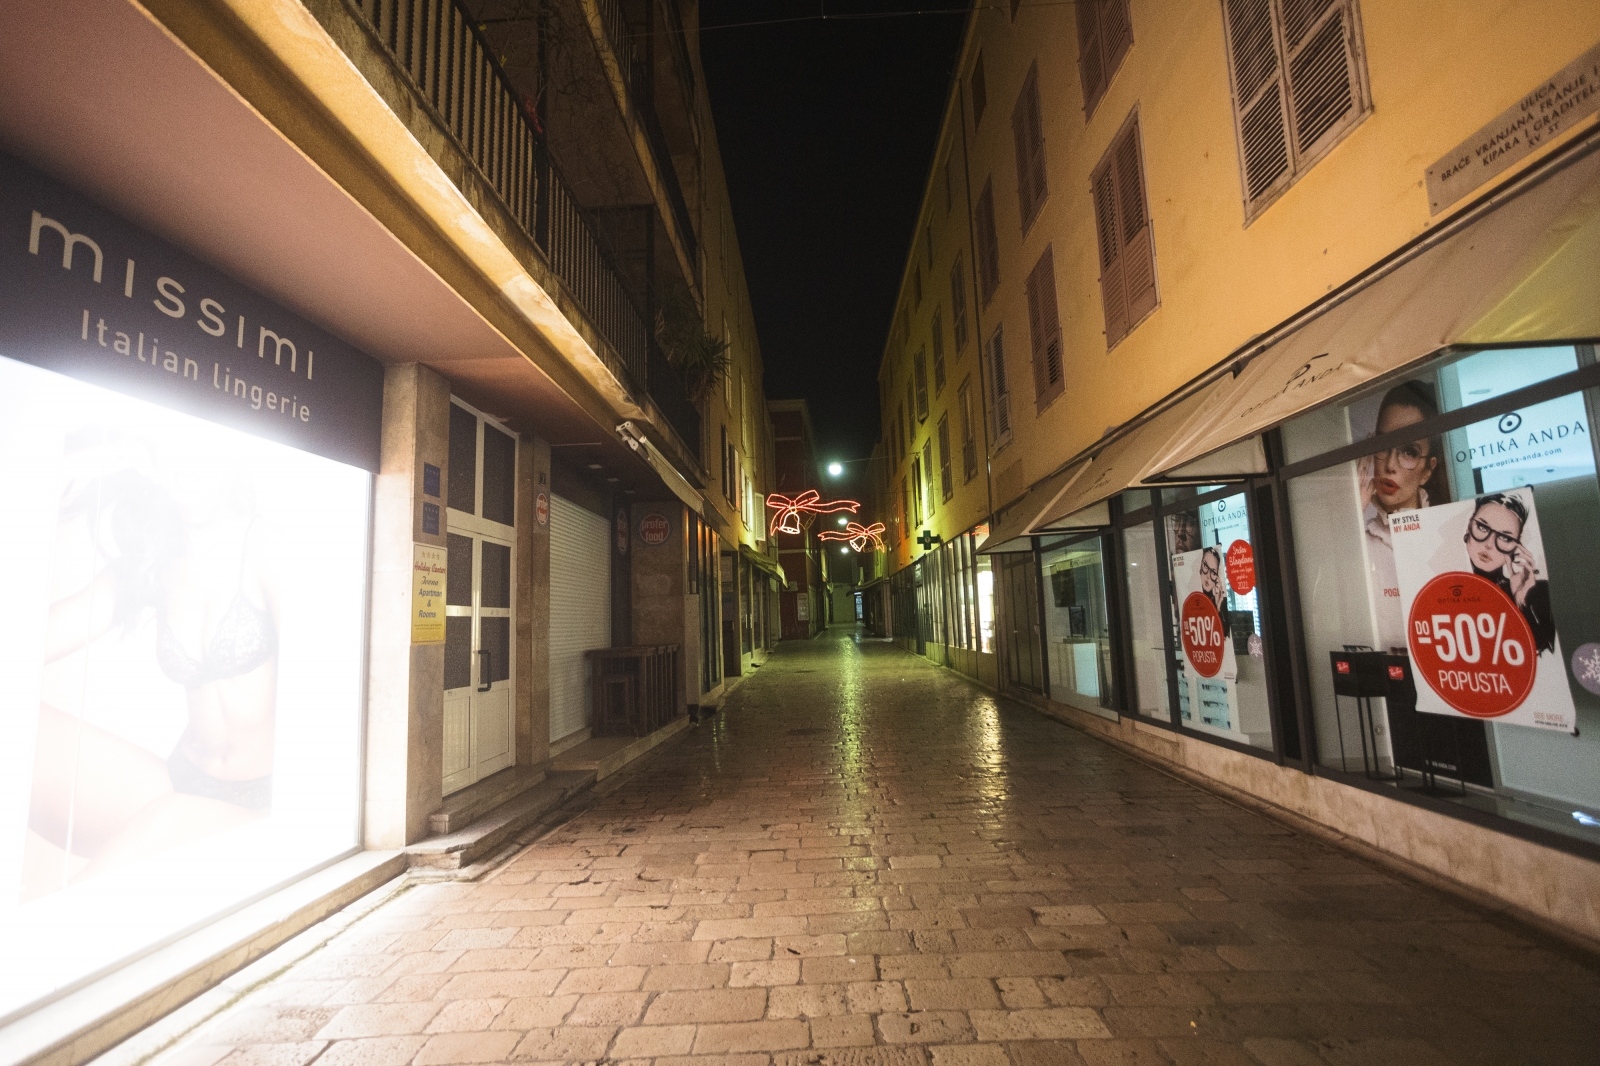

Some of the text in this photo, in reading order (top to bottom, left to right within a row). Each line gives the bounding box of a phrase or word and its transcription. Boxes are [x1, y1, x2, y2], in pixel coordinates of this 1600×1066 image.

[1520, 83, 1556, 111] ULICA
[1475, 113, 1534, 157] VRANJANA
[1540, 74, 1586, 113] FRANJE
[1482, 136, 1520, 166] KIPARA
[1533, 84, 1600, 132] GRADITEL
[1528, 134, 1541, 148] XV
[81, 309, 311, 422] Italian lingerie
[1455, 421, 1585, 462] OPTIKA ANDA
[1203, 509, 1246, 527] OPTIKA ANDA
[1402, 514, 1420, 524] STYLE
[645, 531, 664, 541] food
[1393, 523, 1421, 533] MY ANDA
[1383, 587, 1400, 597] POGL
[418, 609, 436, 618] Rooms
[1414, 620, 1430, 636] DO
[1192, 650, 1217, 663] POPUSTA
[1438, 669, 1513, 695] POPUSTA
